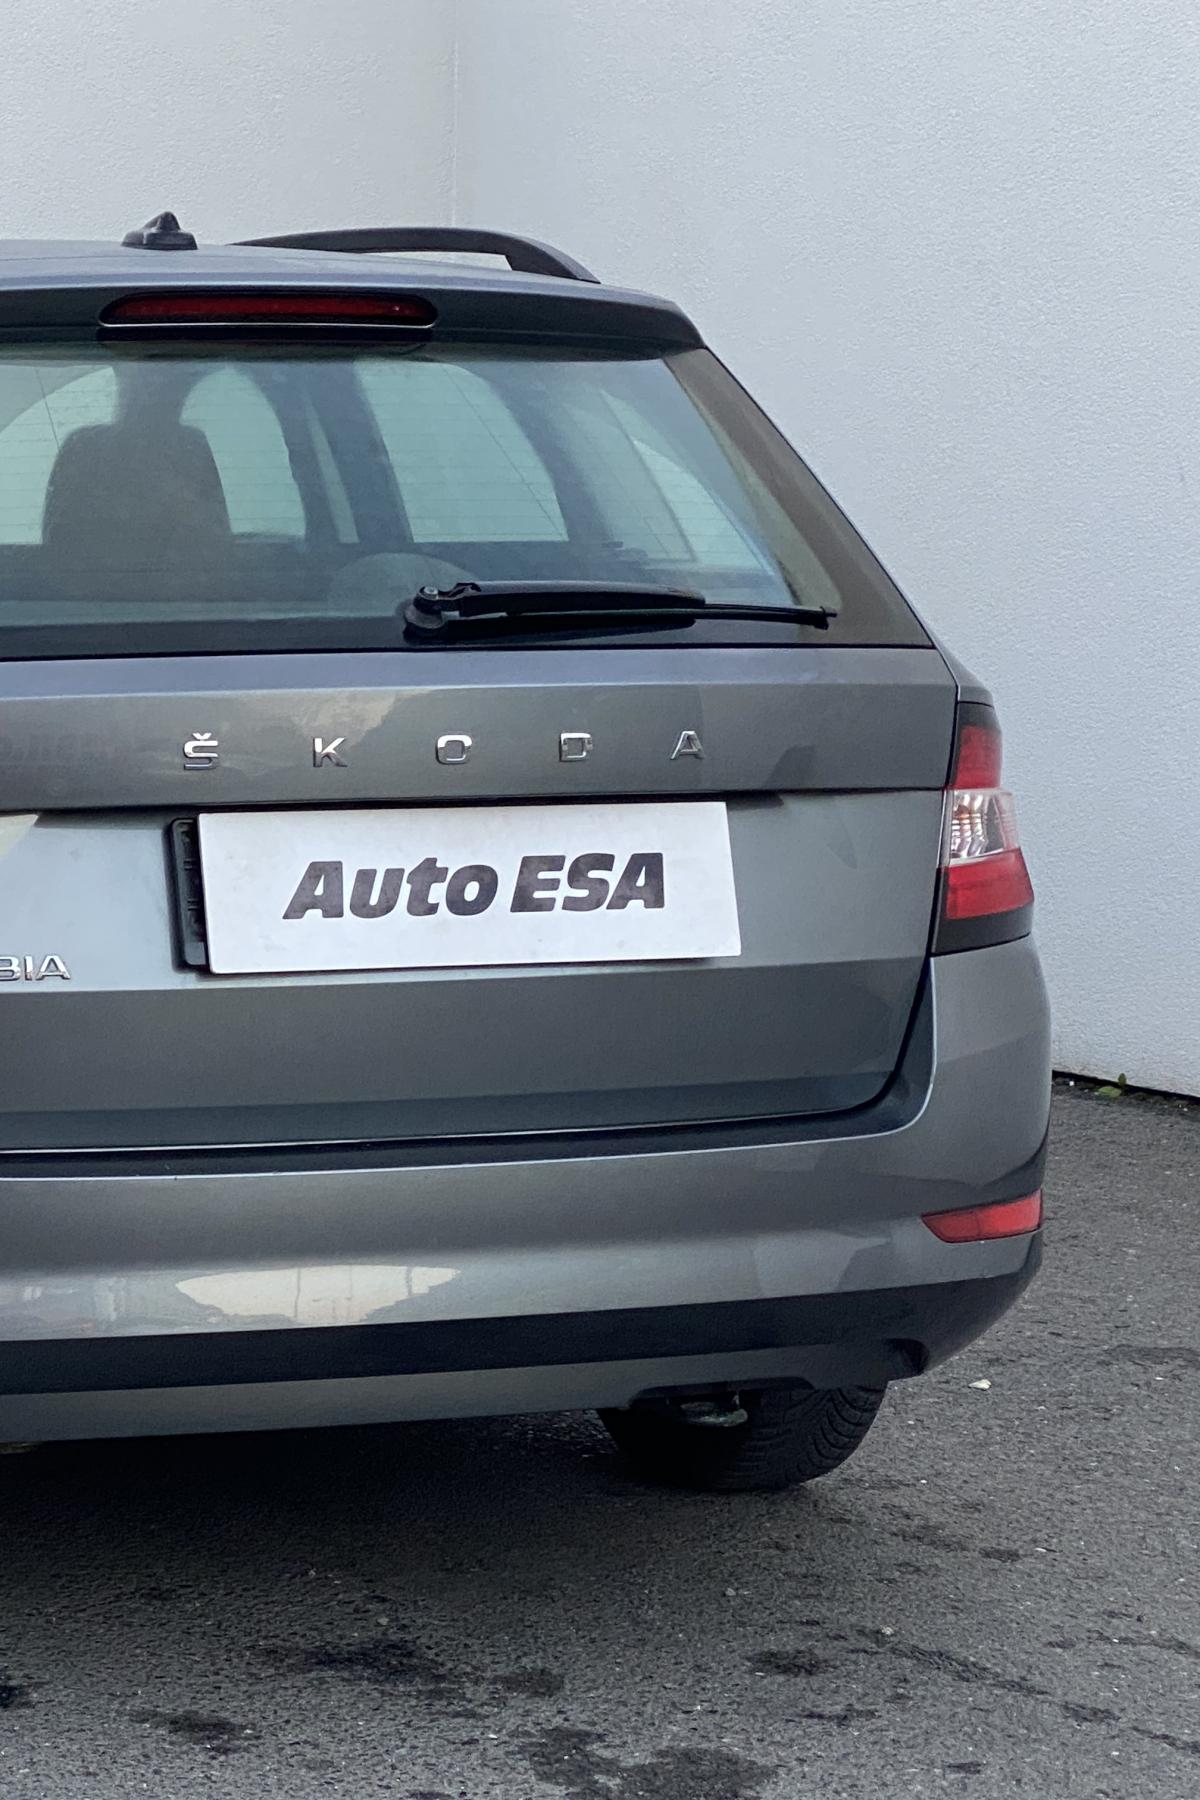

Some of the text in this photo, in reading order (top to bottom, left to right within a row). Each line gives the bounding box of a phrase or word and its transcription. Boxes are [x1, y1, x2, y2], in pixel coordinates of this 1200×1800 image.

[183, 730, 704, 770] ŠKODA
[282, 852, 665, 920] Auto ESA
